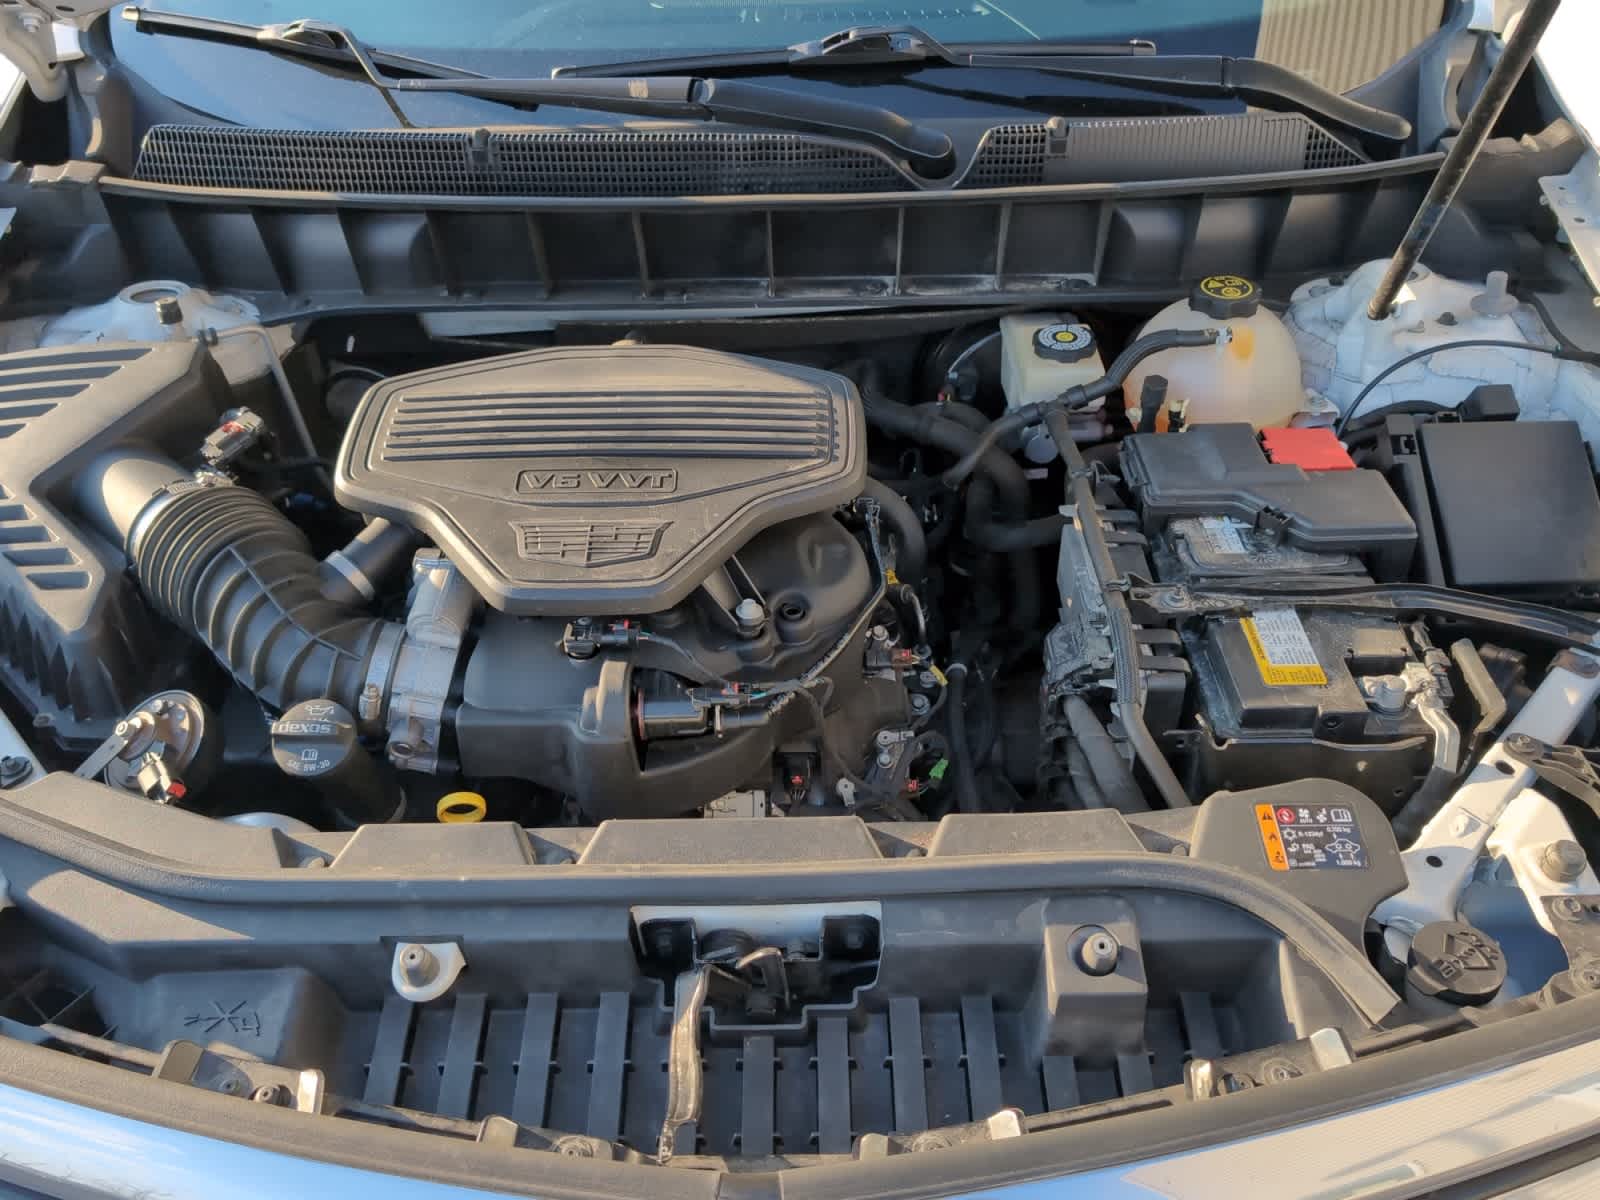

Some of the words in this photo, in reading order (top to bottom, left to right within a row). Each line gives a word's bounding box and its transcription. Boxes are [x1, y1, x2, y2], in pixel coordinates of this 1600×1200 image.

[523, 472, 581, 489] V6
[587, 471, 673, 489] VVT
[278, 720, 332, 734] dexos
